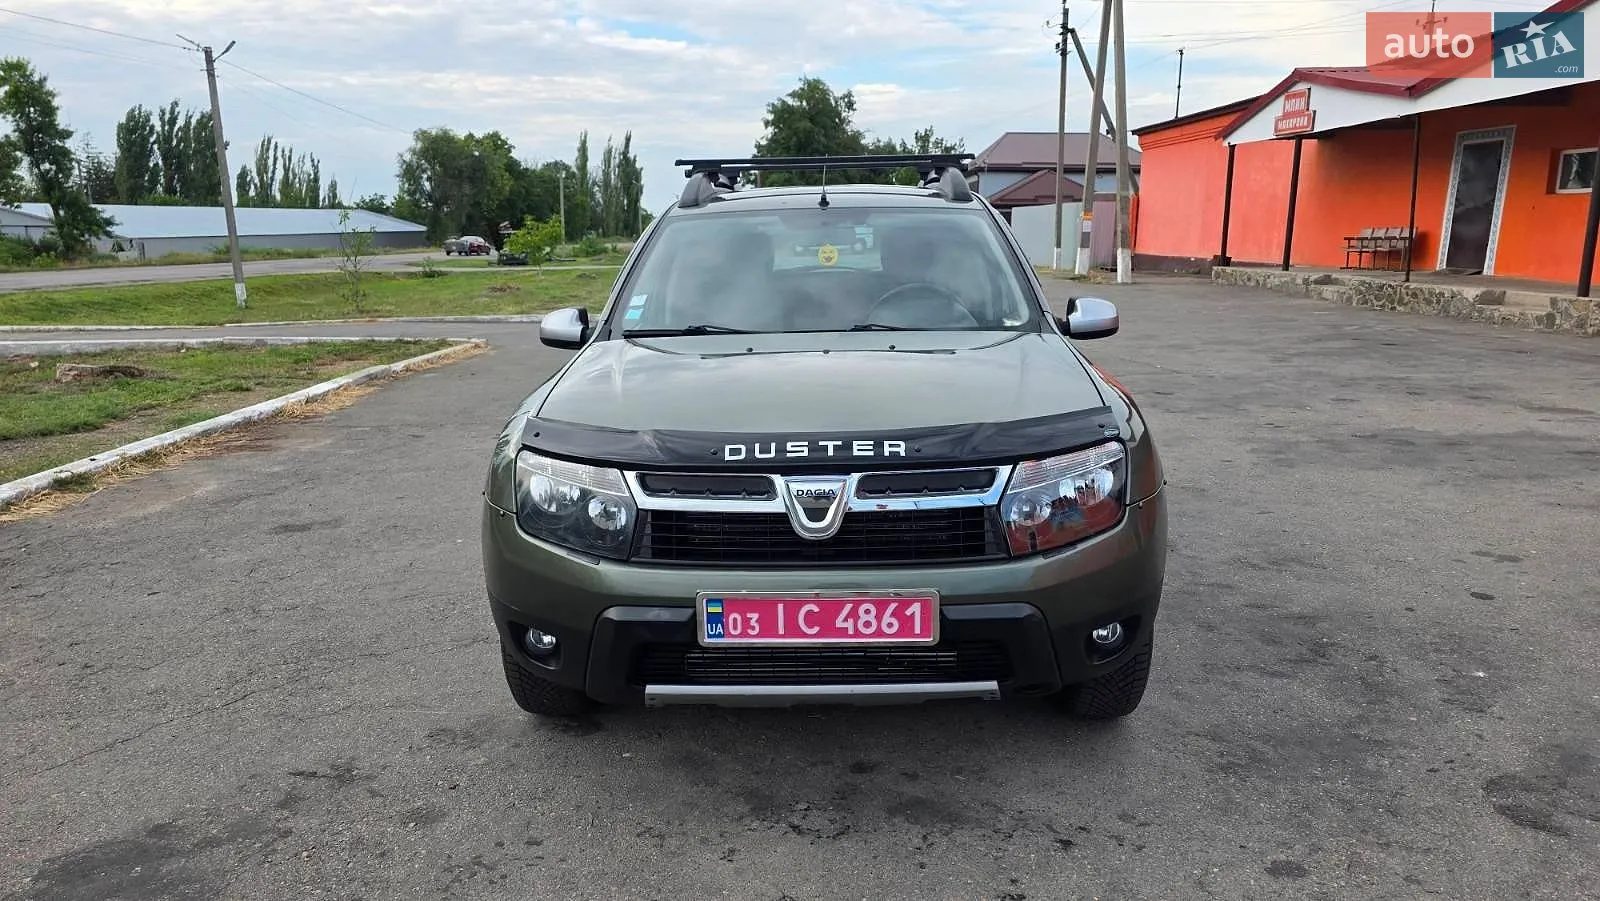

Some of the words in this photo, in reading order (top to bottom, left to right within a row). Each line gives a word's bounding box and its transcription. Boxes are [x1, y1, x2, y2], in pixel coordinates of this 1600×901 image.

[724, 440, 907, 462] DUSTER
[707, 623, 724, 635] UA
[728, 612, 760, 635] 03
[835, 602, 922, 635] 4861
